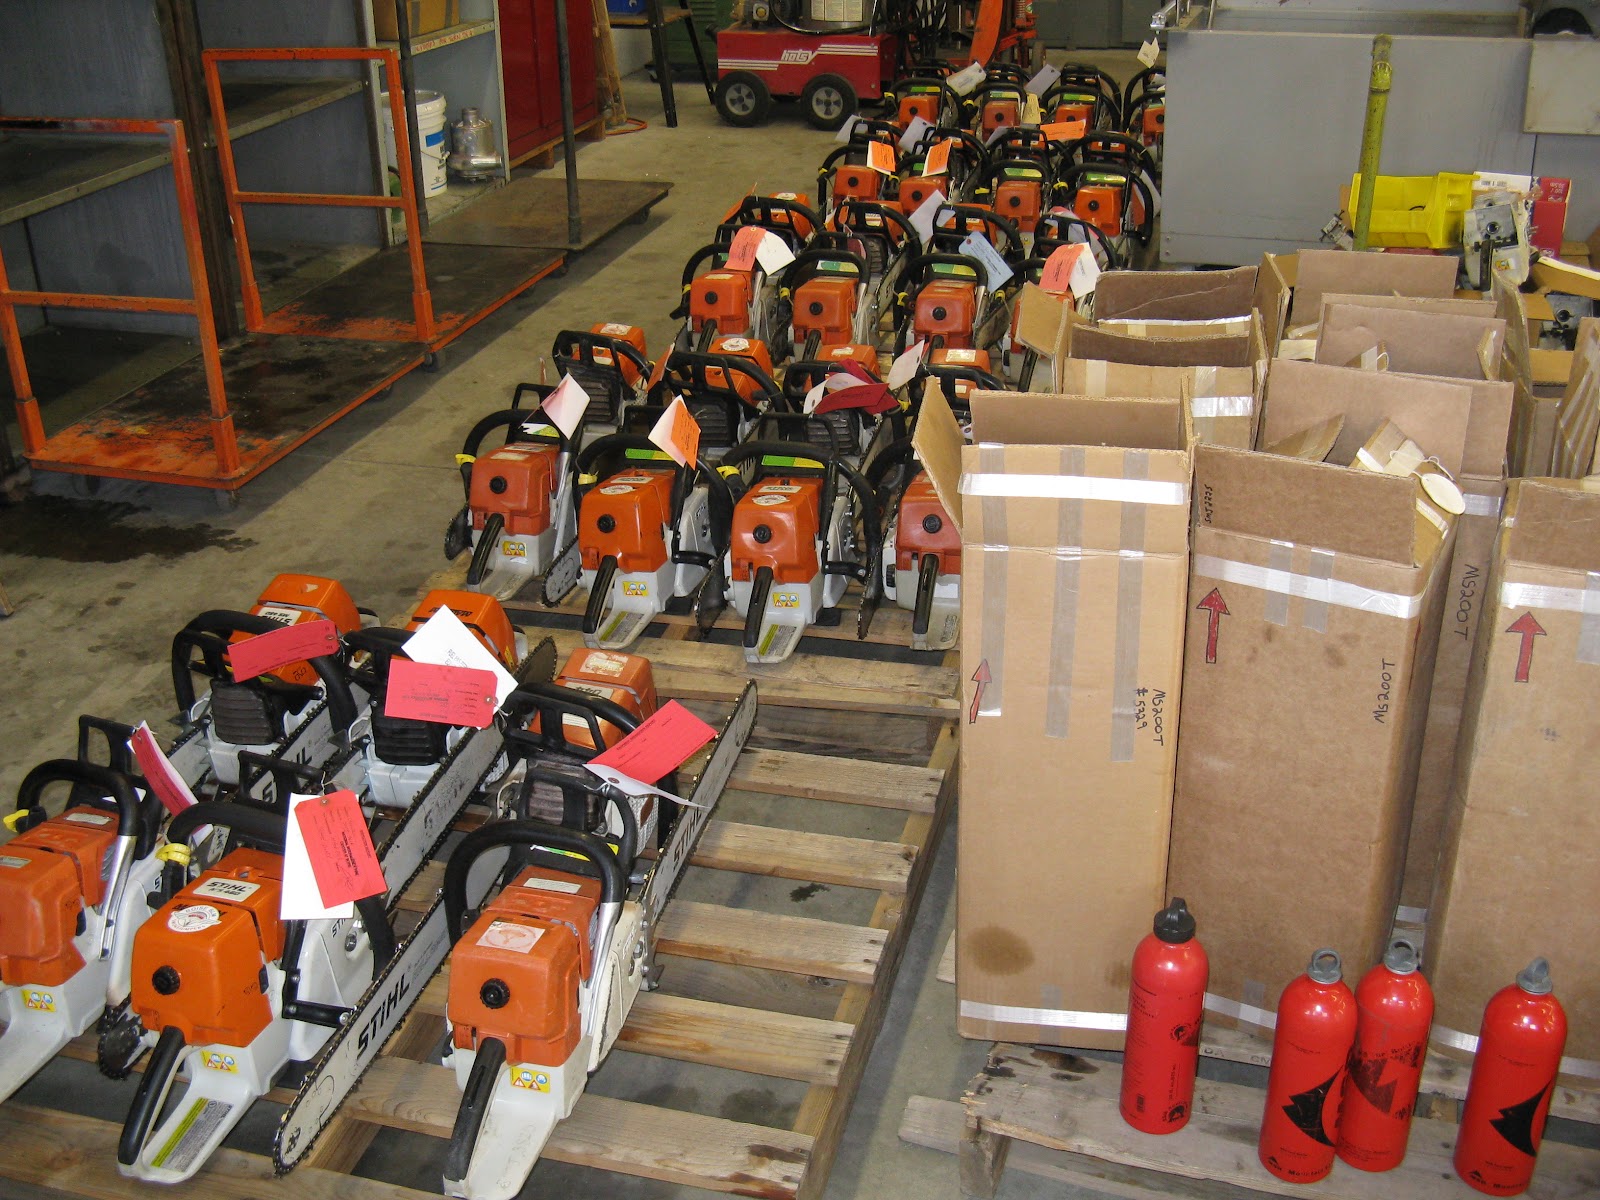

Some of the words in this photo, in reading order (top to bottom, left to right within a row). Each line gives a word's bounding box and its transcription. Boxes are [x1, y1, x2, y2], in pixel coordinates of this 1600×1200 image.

[1453, 564, 1480, 640] MS200T
[1152, 688, 1166, 746] MS200T
[1372, 658, 1395, 723] MS200T
[673, 807, 702, 872] STIHL
[206, 881, 246, 892] STIHL
[357, 973, 410, 1061] STIHL
